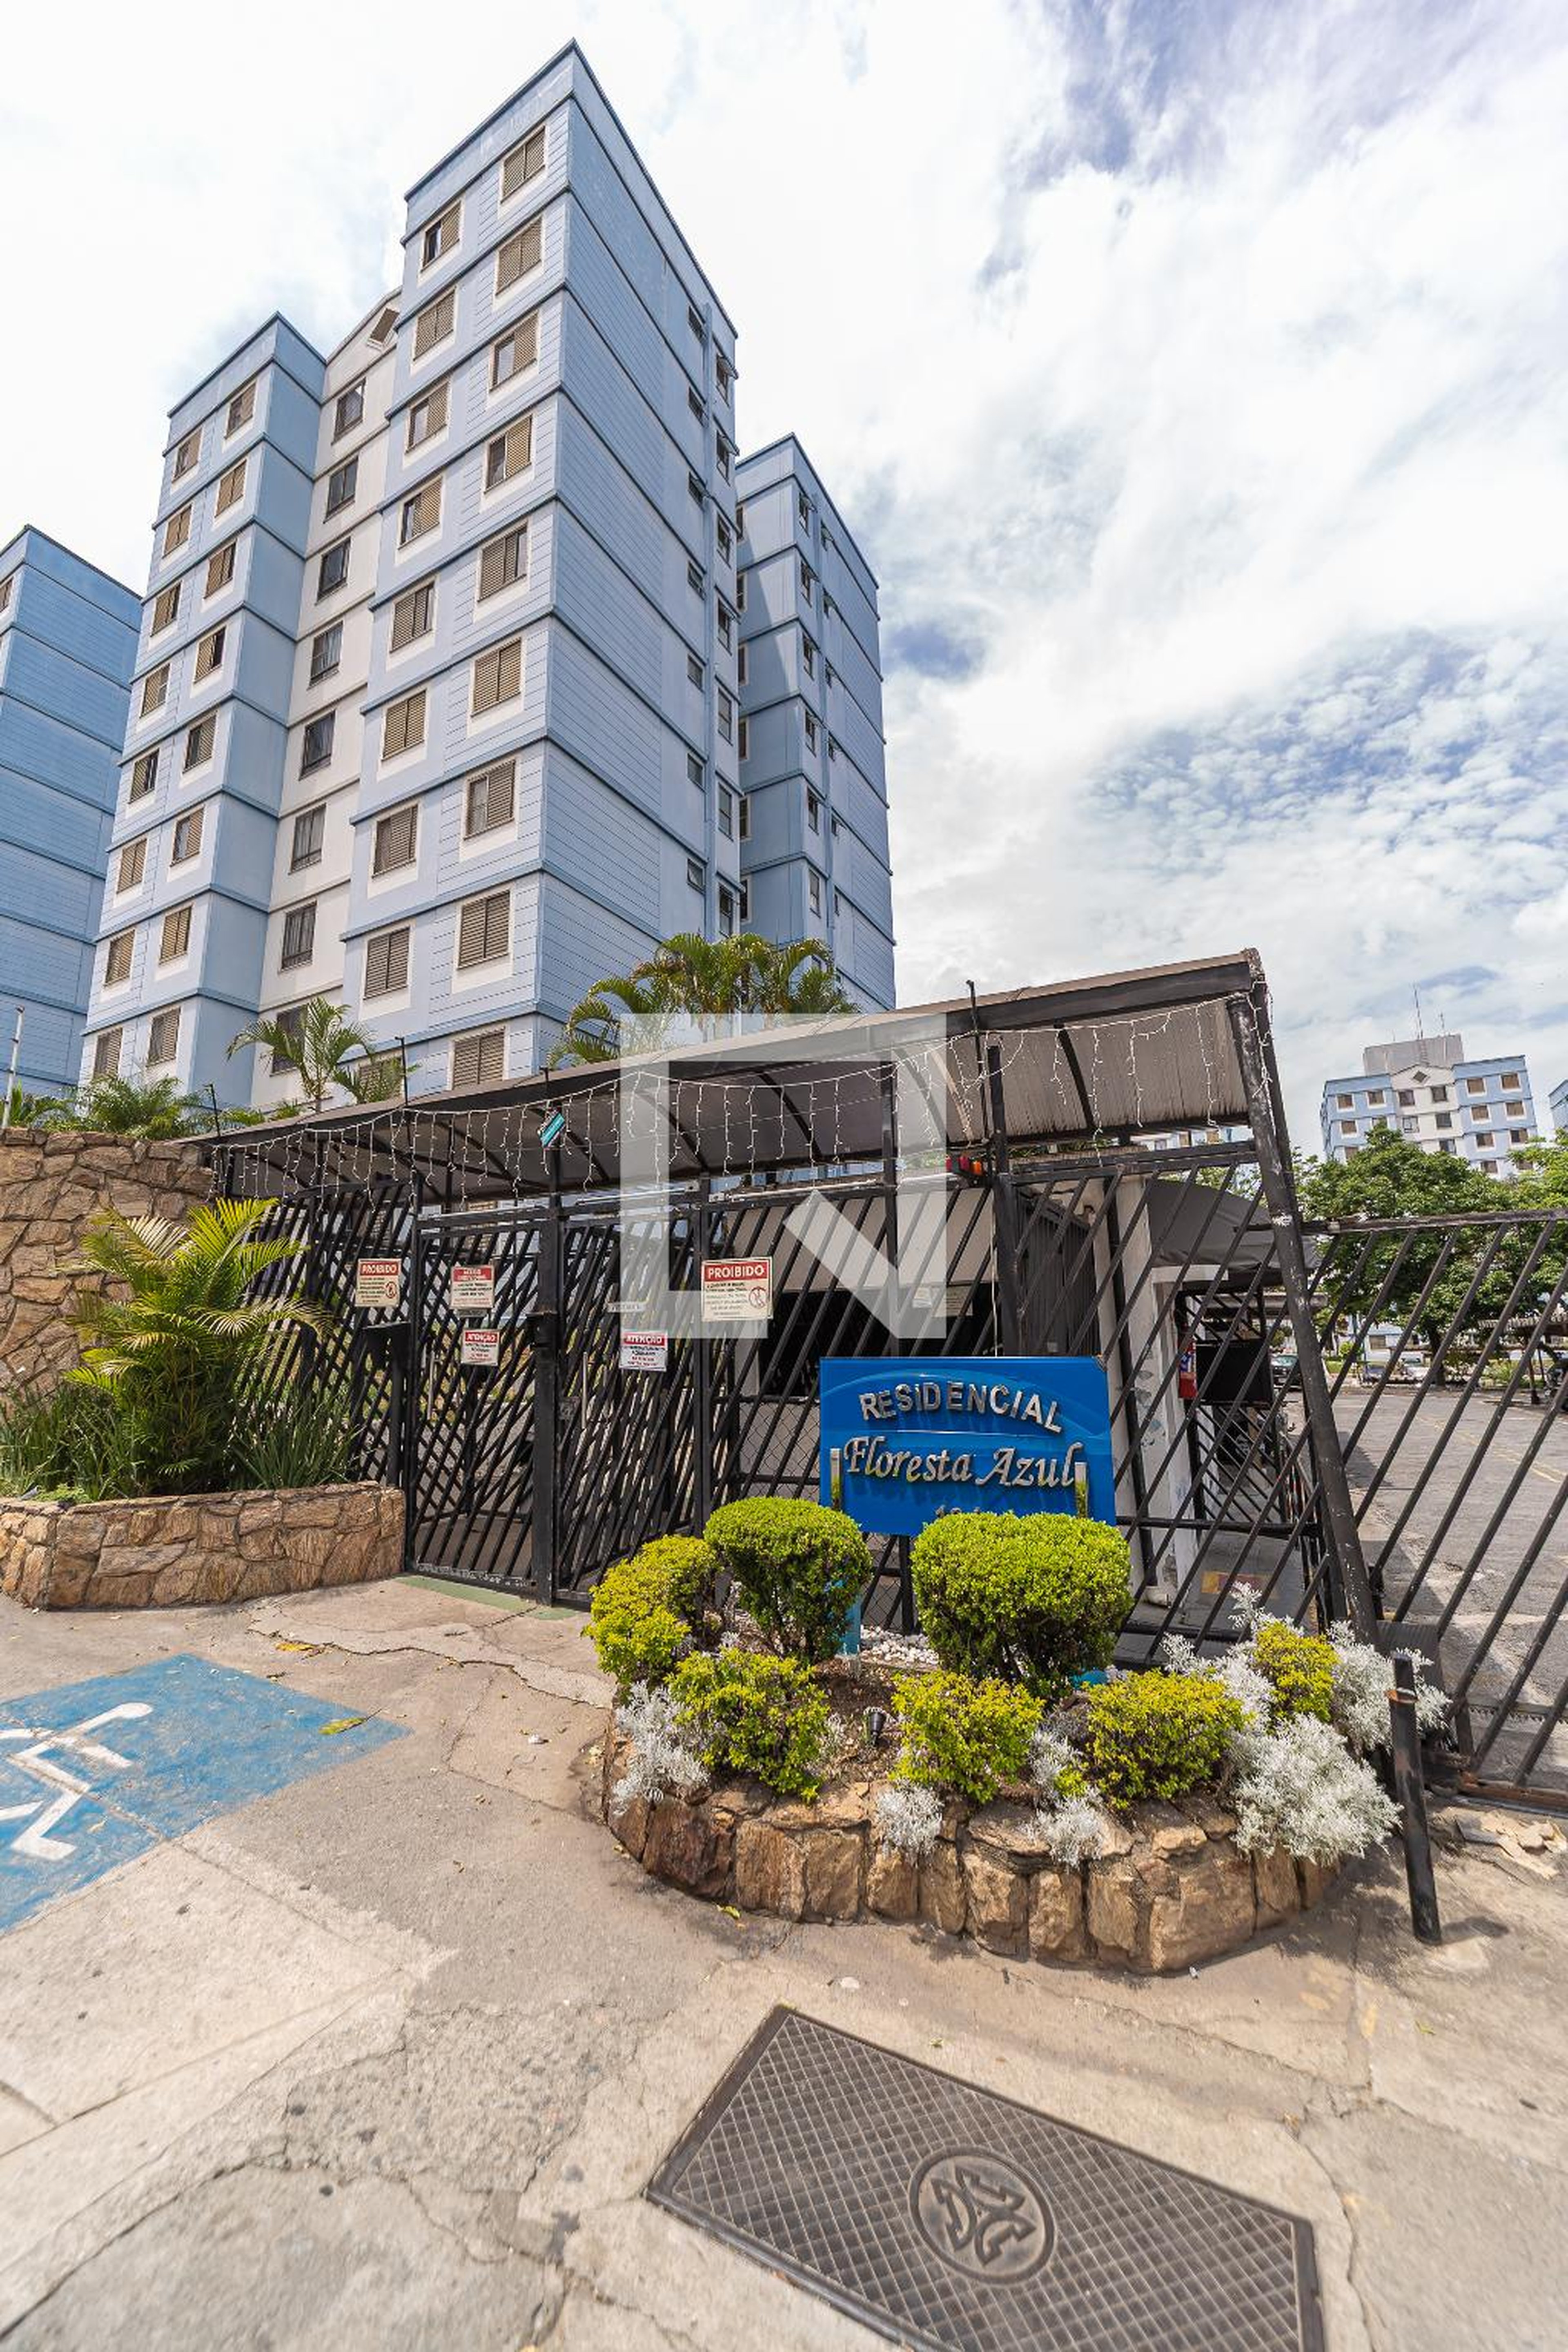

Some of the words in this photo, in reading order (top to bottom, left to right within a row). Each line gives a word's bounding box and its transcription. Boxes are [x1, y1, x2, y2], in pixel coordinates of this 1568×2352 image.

[708, 1265, 765, 1279] PROIBIDO
[859, 1381, 1062, 1434] RESIDENCIAL
[843, 1436, 973, 1483] Floresta
[975, 1441, 1084, 1487] Azul
